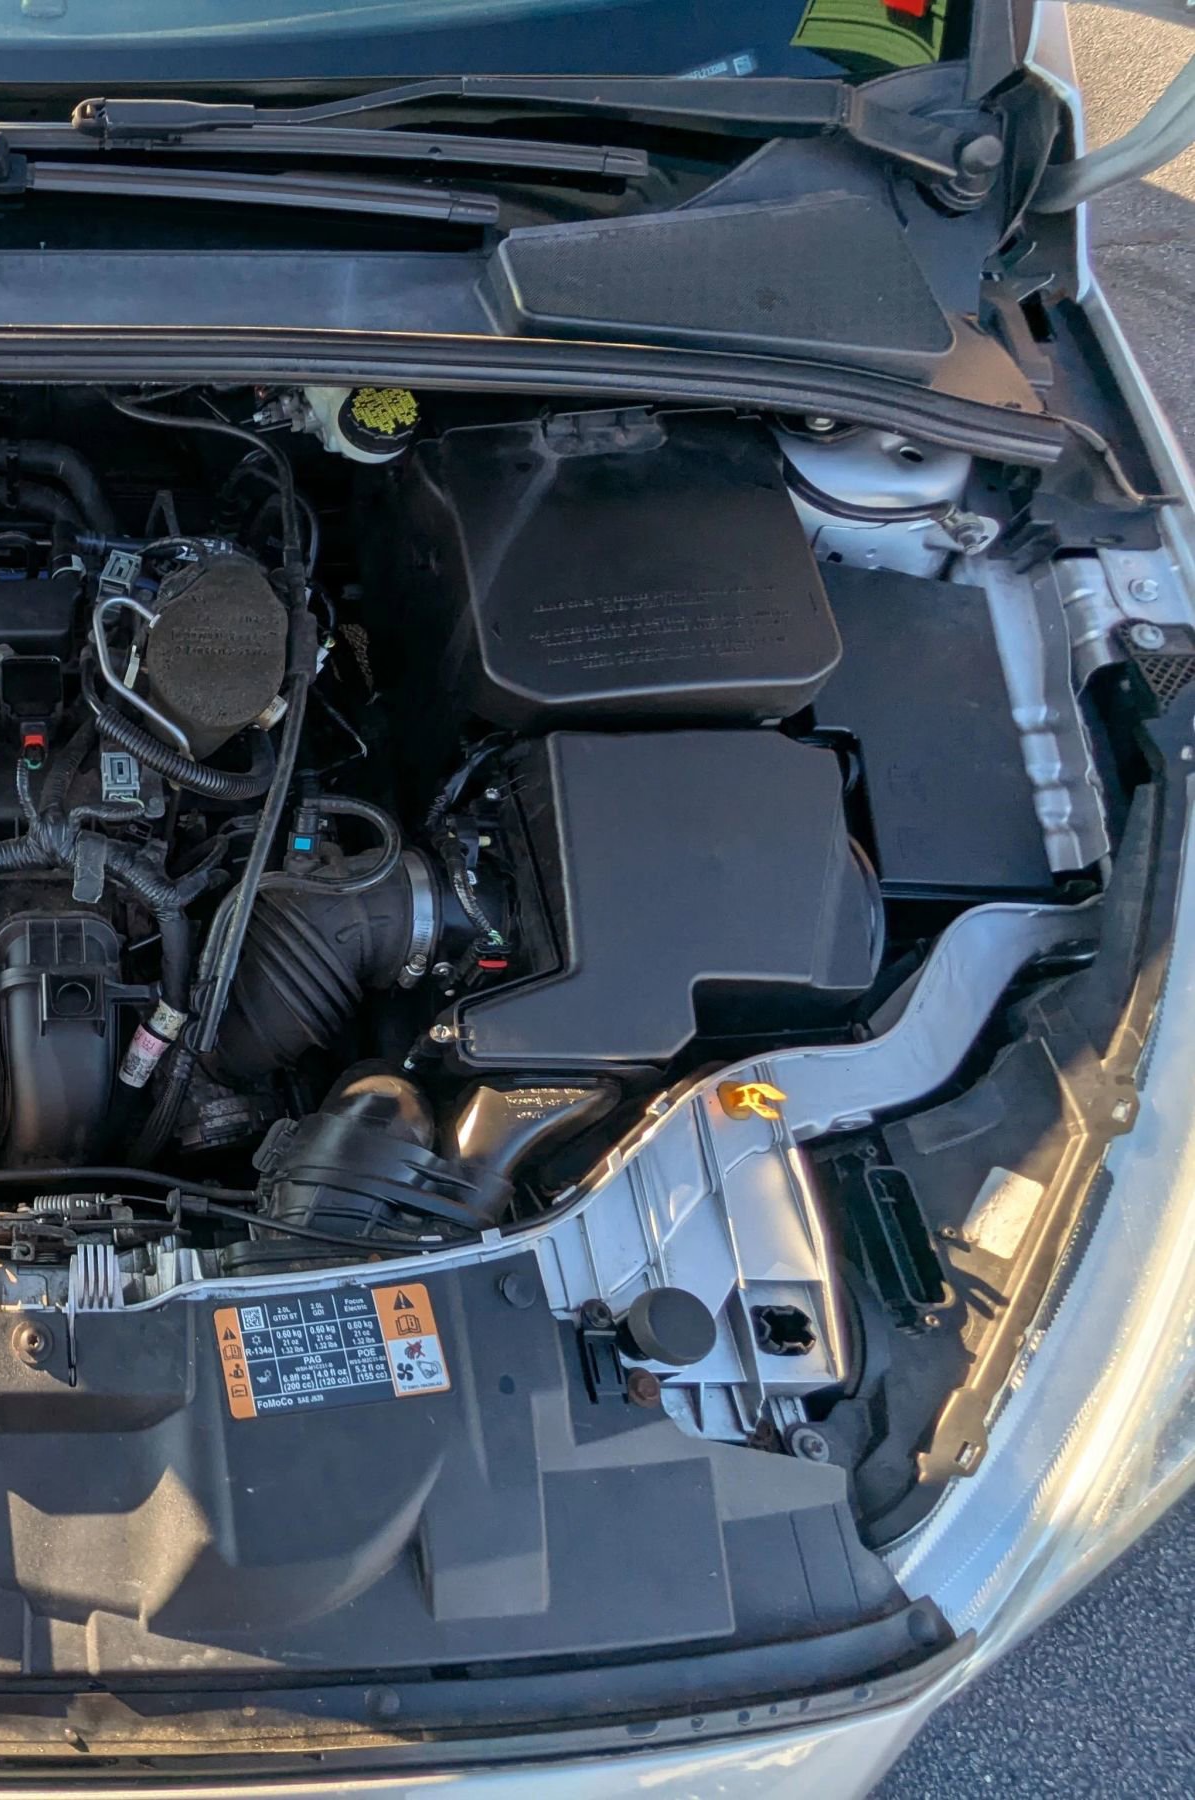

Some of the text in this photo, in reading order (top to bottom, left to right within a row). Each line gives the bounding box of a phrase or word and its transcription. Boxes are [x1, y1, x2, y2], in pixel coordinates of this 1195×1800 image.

[344, 1304, 368, 1312] Electric
[273, 1314, 290, 1322] GTDI
[310, 1324, 336, 1334] 0.60 kg
[347, 1320, 373, 1330] 0.60 kg
[276, 1329, 302, 1339] 0.60 kg
[245, 1346, 272, 1357] R-134a
[357, 1348, 376, 1358] POE
[303, 1356, 322, 1364] PAG
[316, 1370, 329, 1378] 4.0
[354, 1365, 367, 1374] 5.2
[357, 1370, 388, 1383] (155 cc)
[284, 1381, 314, 1392] (200 cc)
[319, 1376, 350, 1388] (120 cc)
[257, 1400, 293, 1409] FoMoCo
